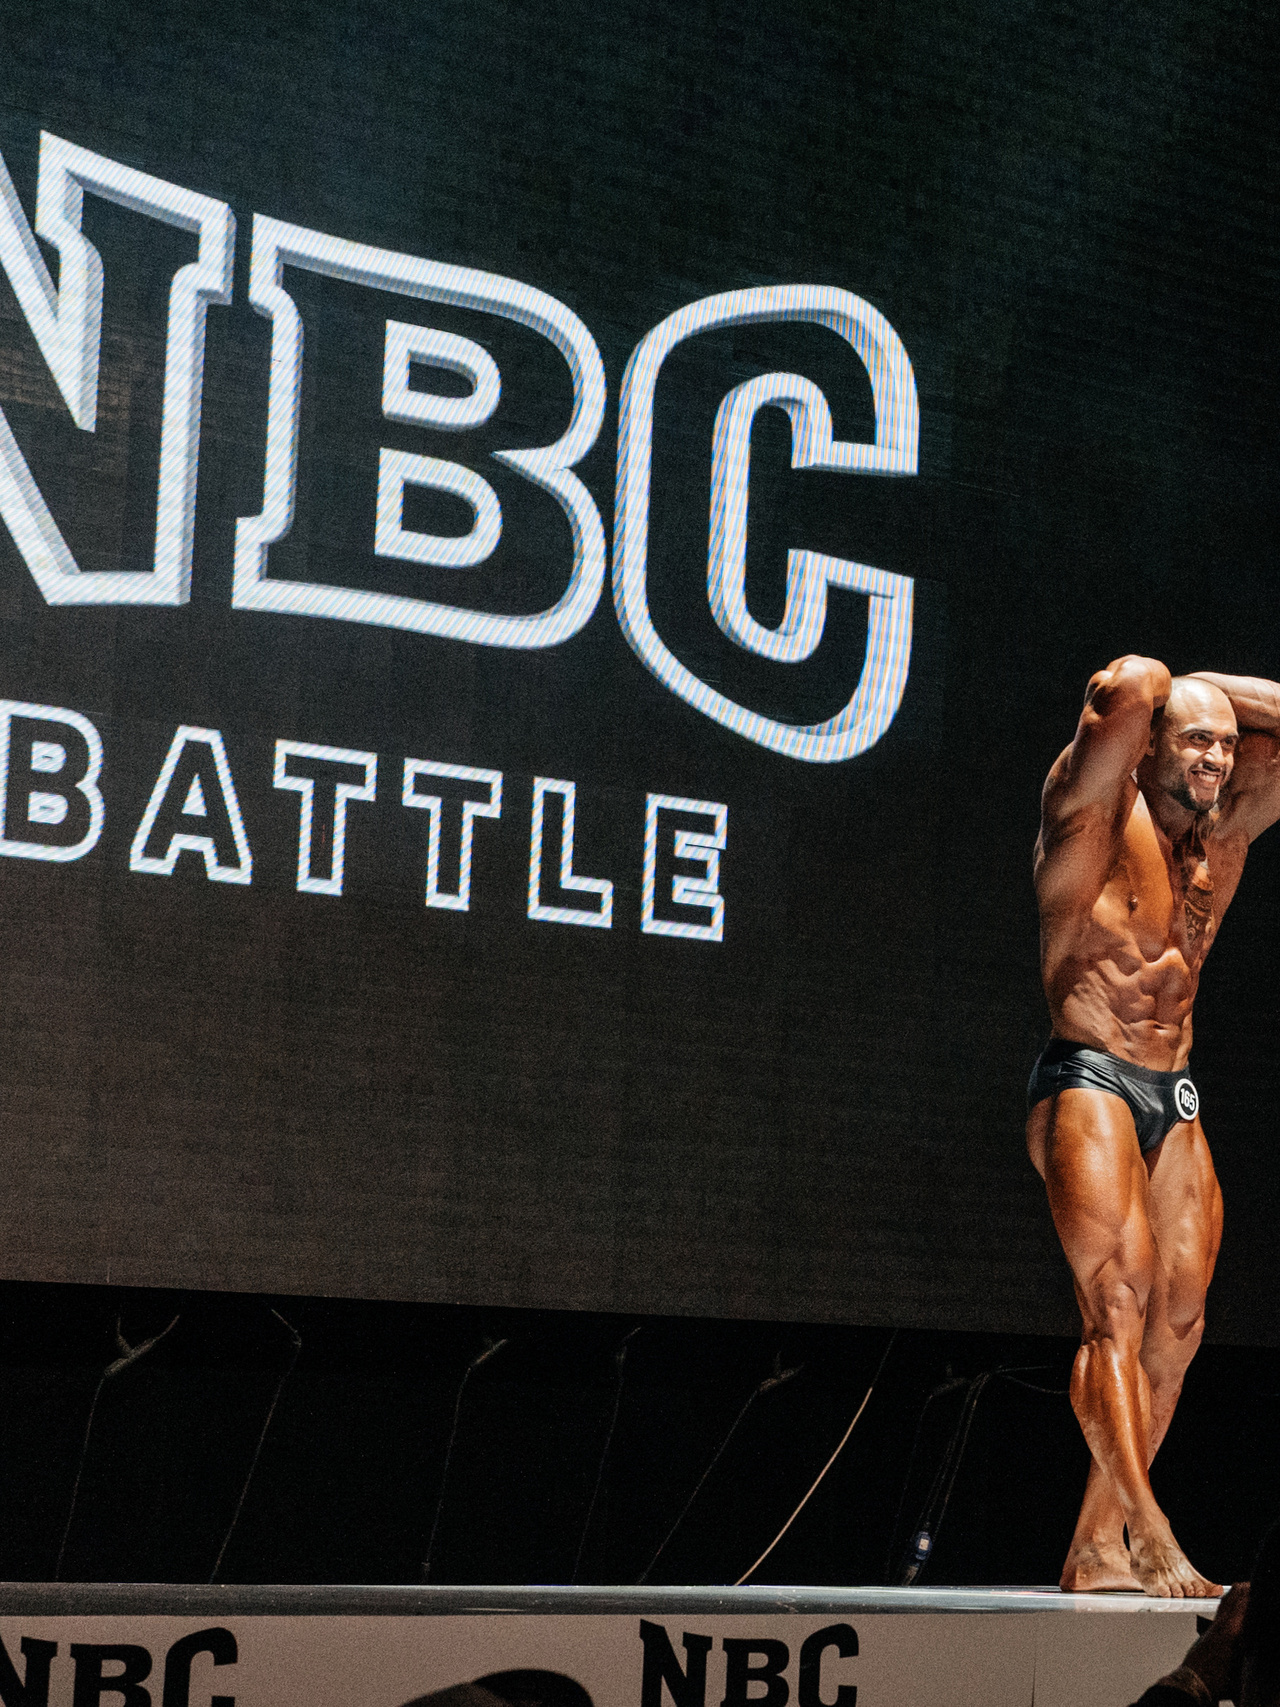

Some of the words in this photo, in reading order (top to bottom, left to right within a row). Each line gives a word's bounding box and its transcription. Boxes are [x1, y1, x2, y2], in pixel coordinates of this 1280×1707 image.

[0, 130, 920, 763] NBC
[0, 700, 728, 942] BATTLE
[1180, 1088, 1196, 1111] 165
[639, 1619, 859, 1707] NBC
